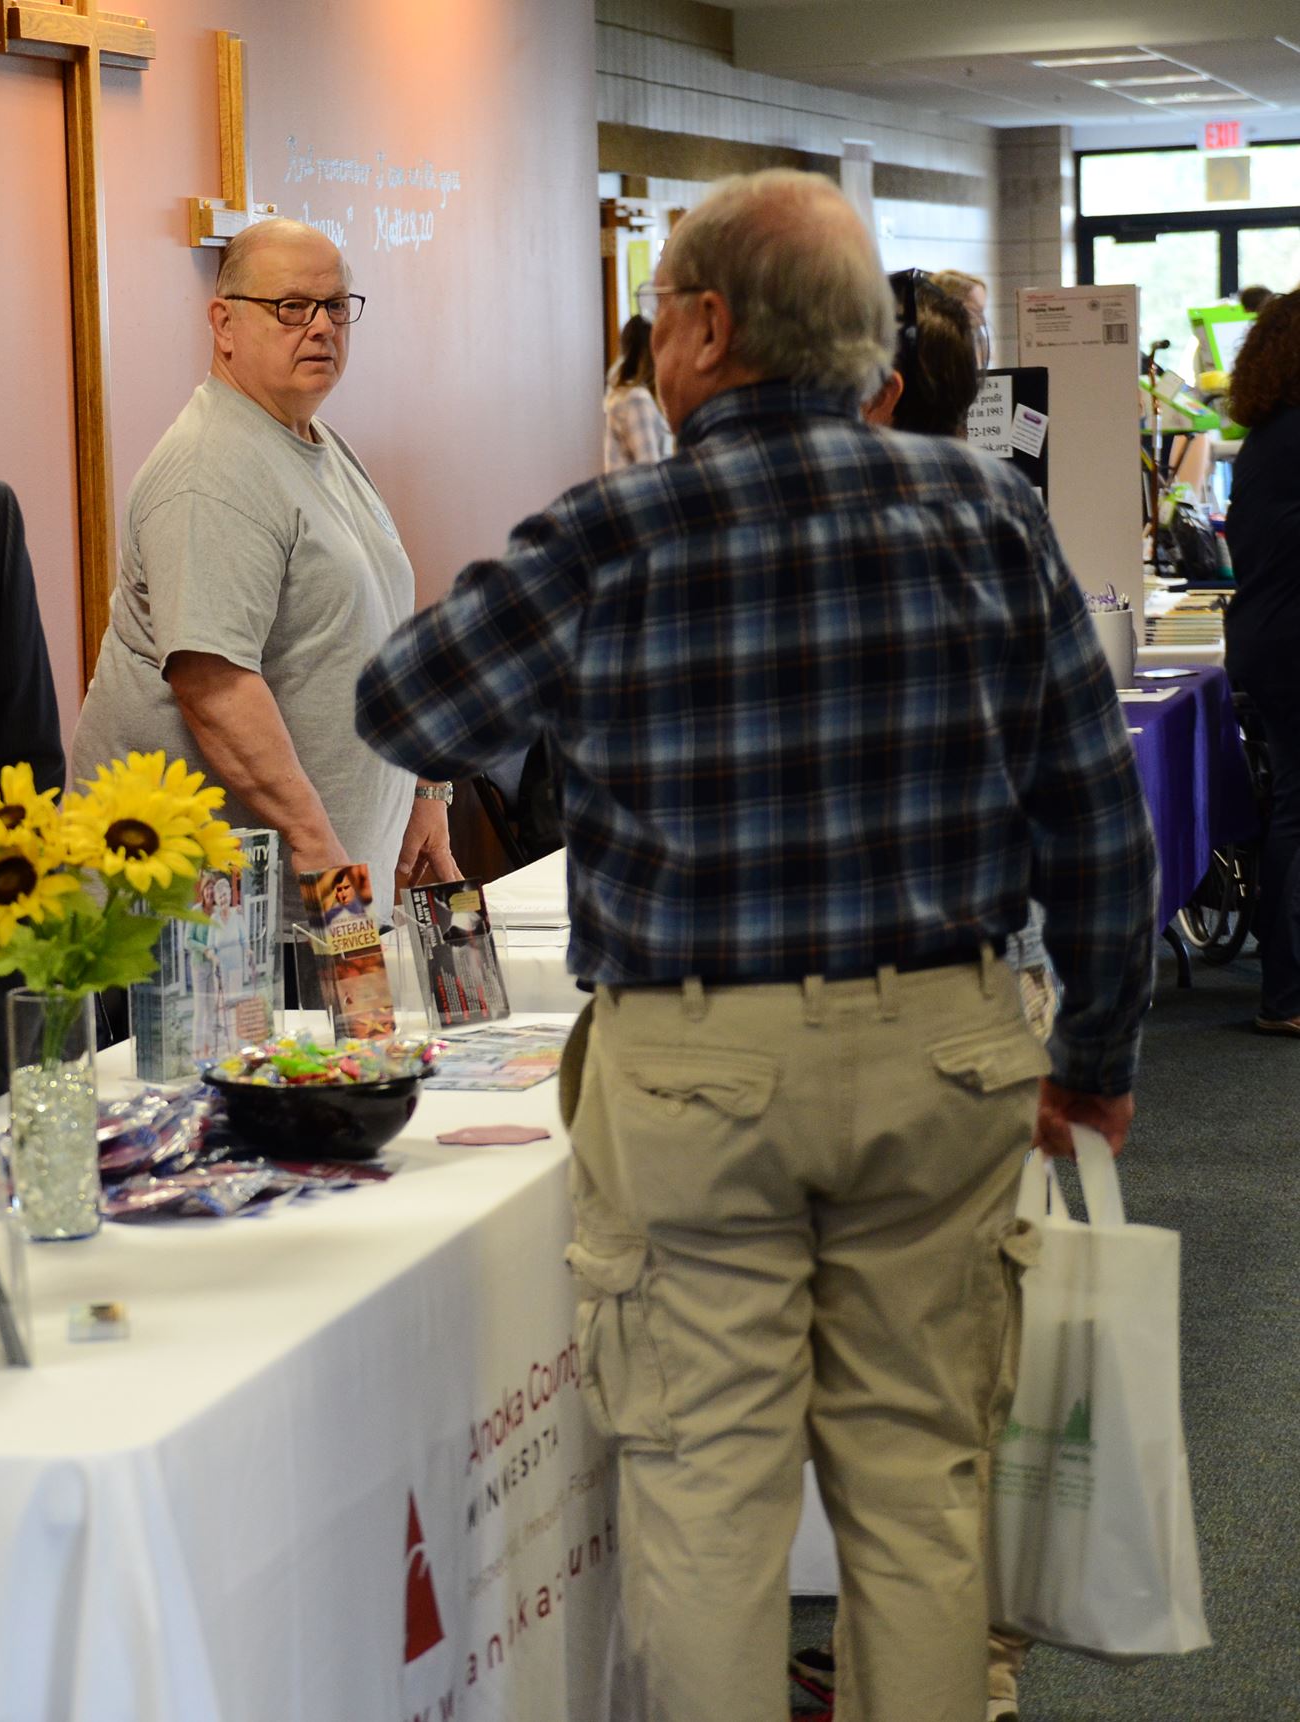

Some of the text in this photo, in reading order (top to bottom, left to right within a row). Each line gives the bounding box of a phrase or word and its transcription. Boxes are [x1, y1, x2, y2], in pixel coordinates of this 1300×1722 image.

[1205, 121, 1241, 149] EXIT
[331, 919, 374, 938] VETERAN
[332, 932, 377, 952] SERVICES
